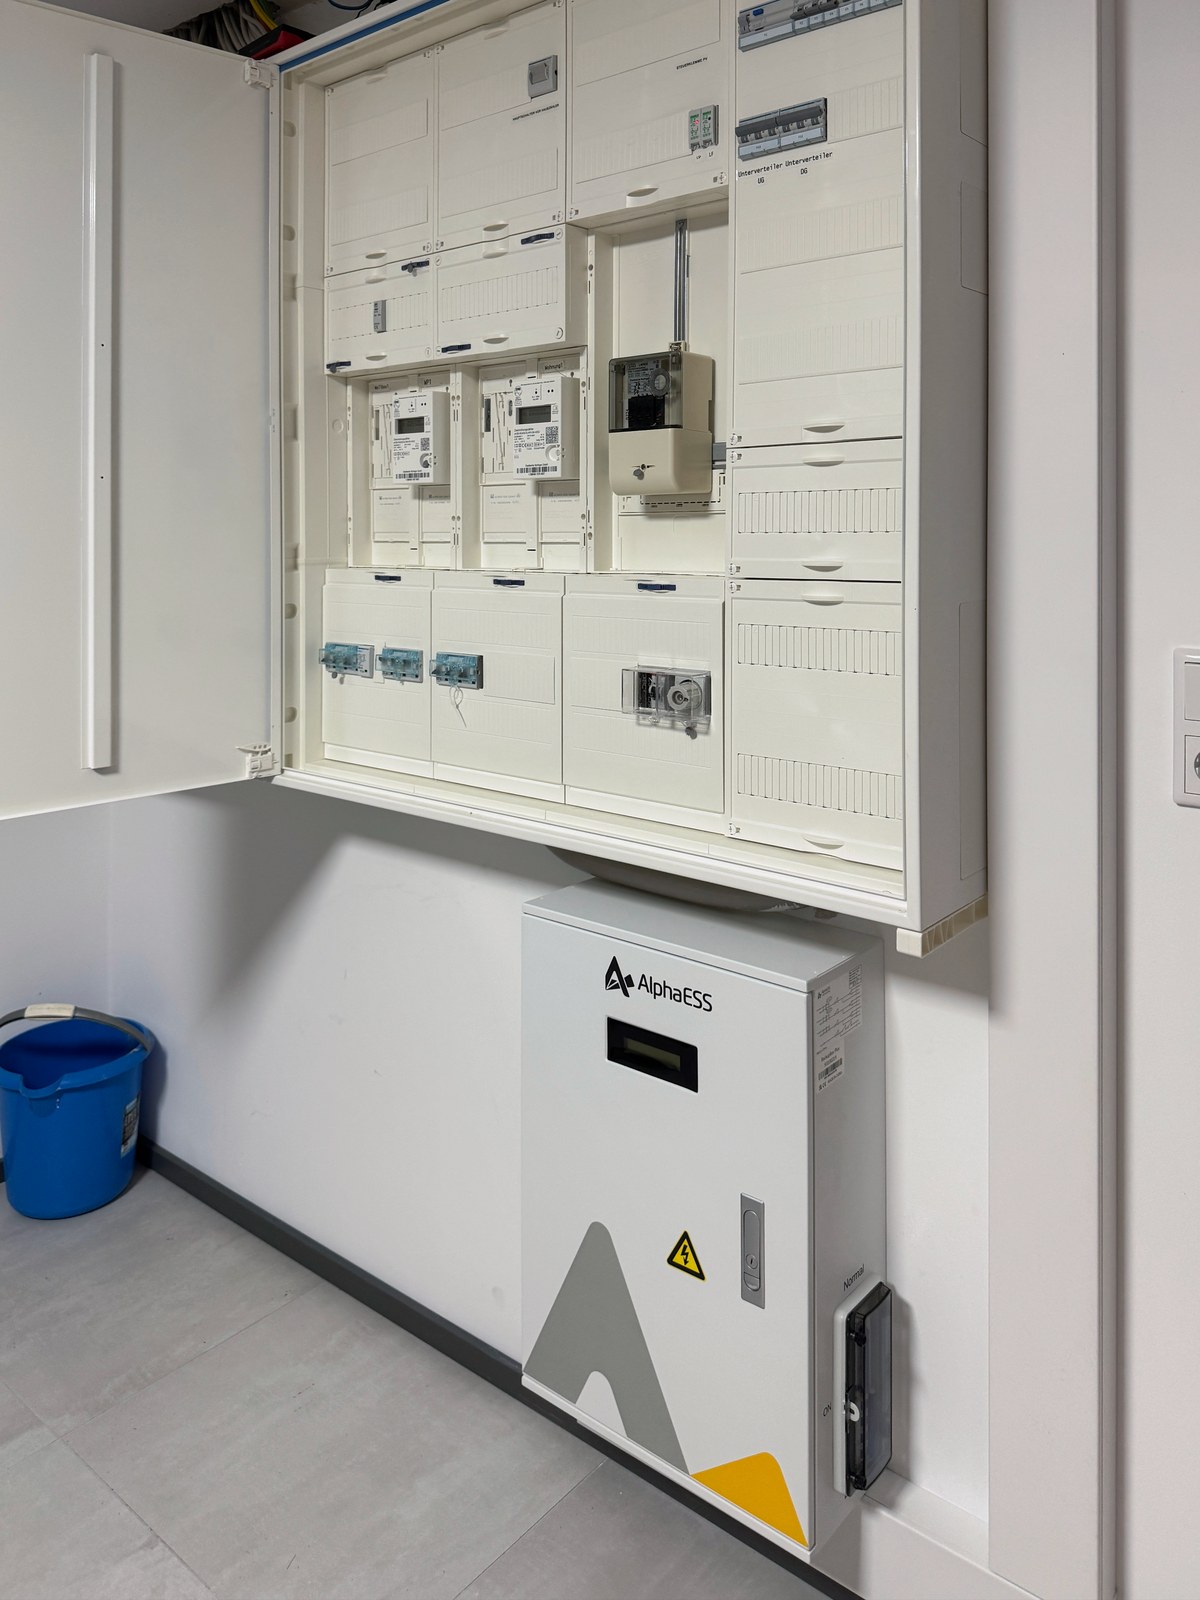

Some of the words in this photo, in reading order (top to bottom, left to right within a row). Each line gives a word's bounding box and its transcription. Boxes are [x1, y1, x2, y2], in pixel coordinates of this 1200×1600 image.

[737, 163, 782, 177] Unterverteiler
[785, 152, 832, 167] Unterverteiler
[800, 167, 808, 175] DG
[638, 973, 713, 1012] AlphaESS
[843, 1264, 865, 1291] Normal
